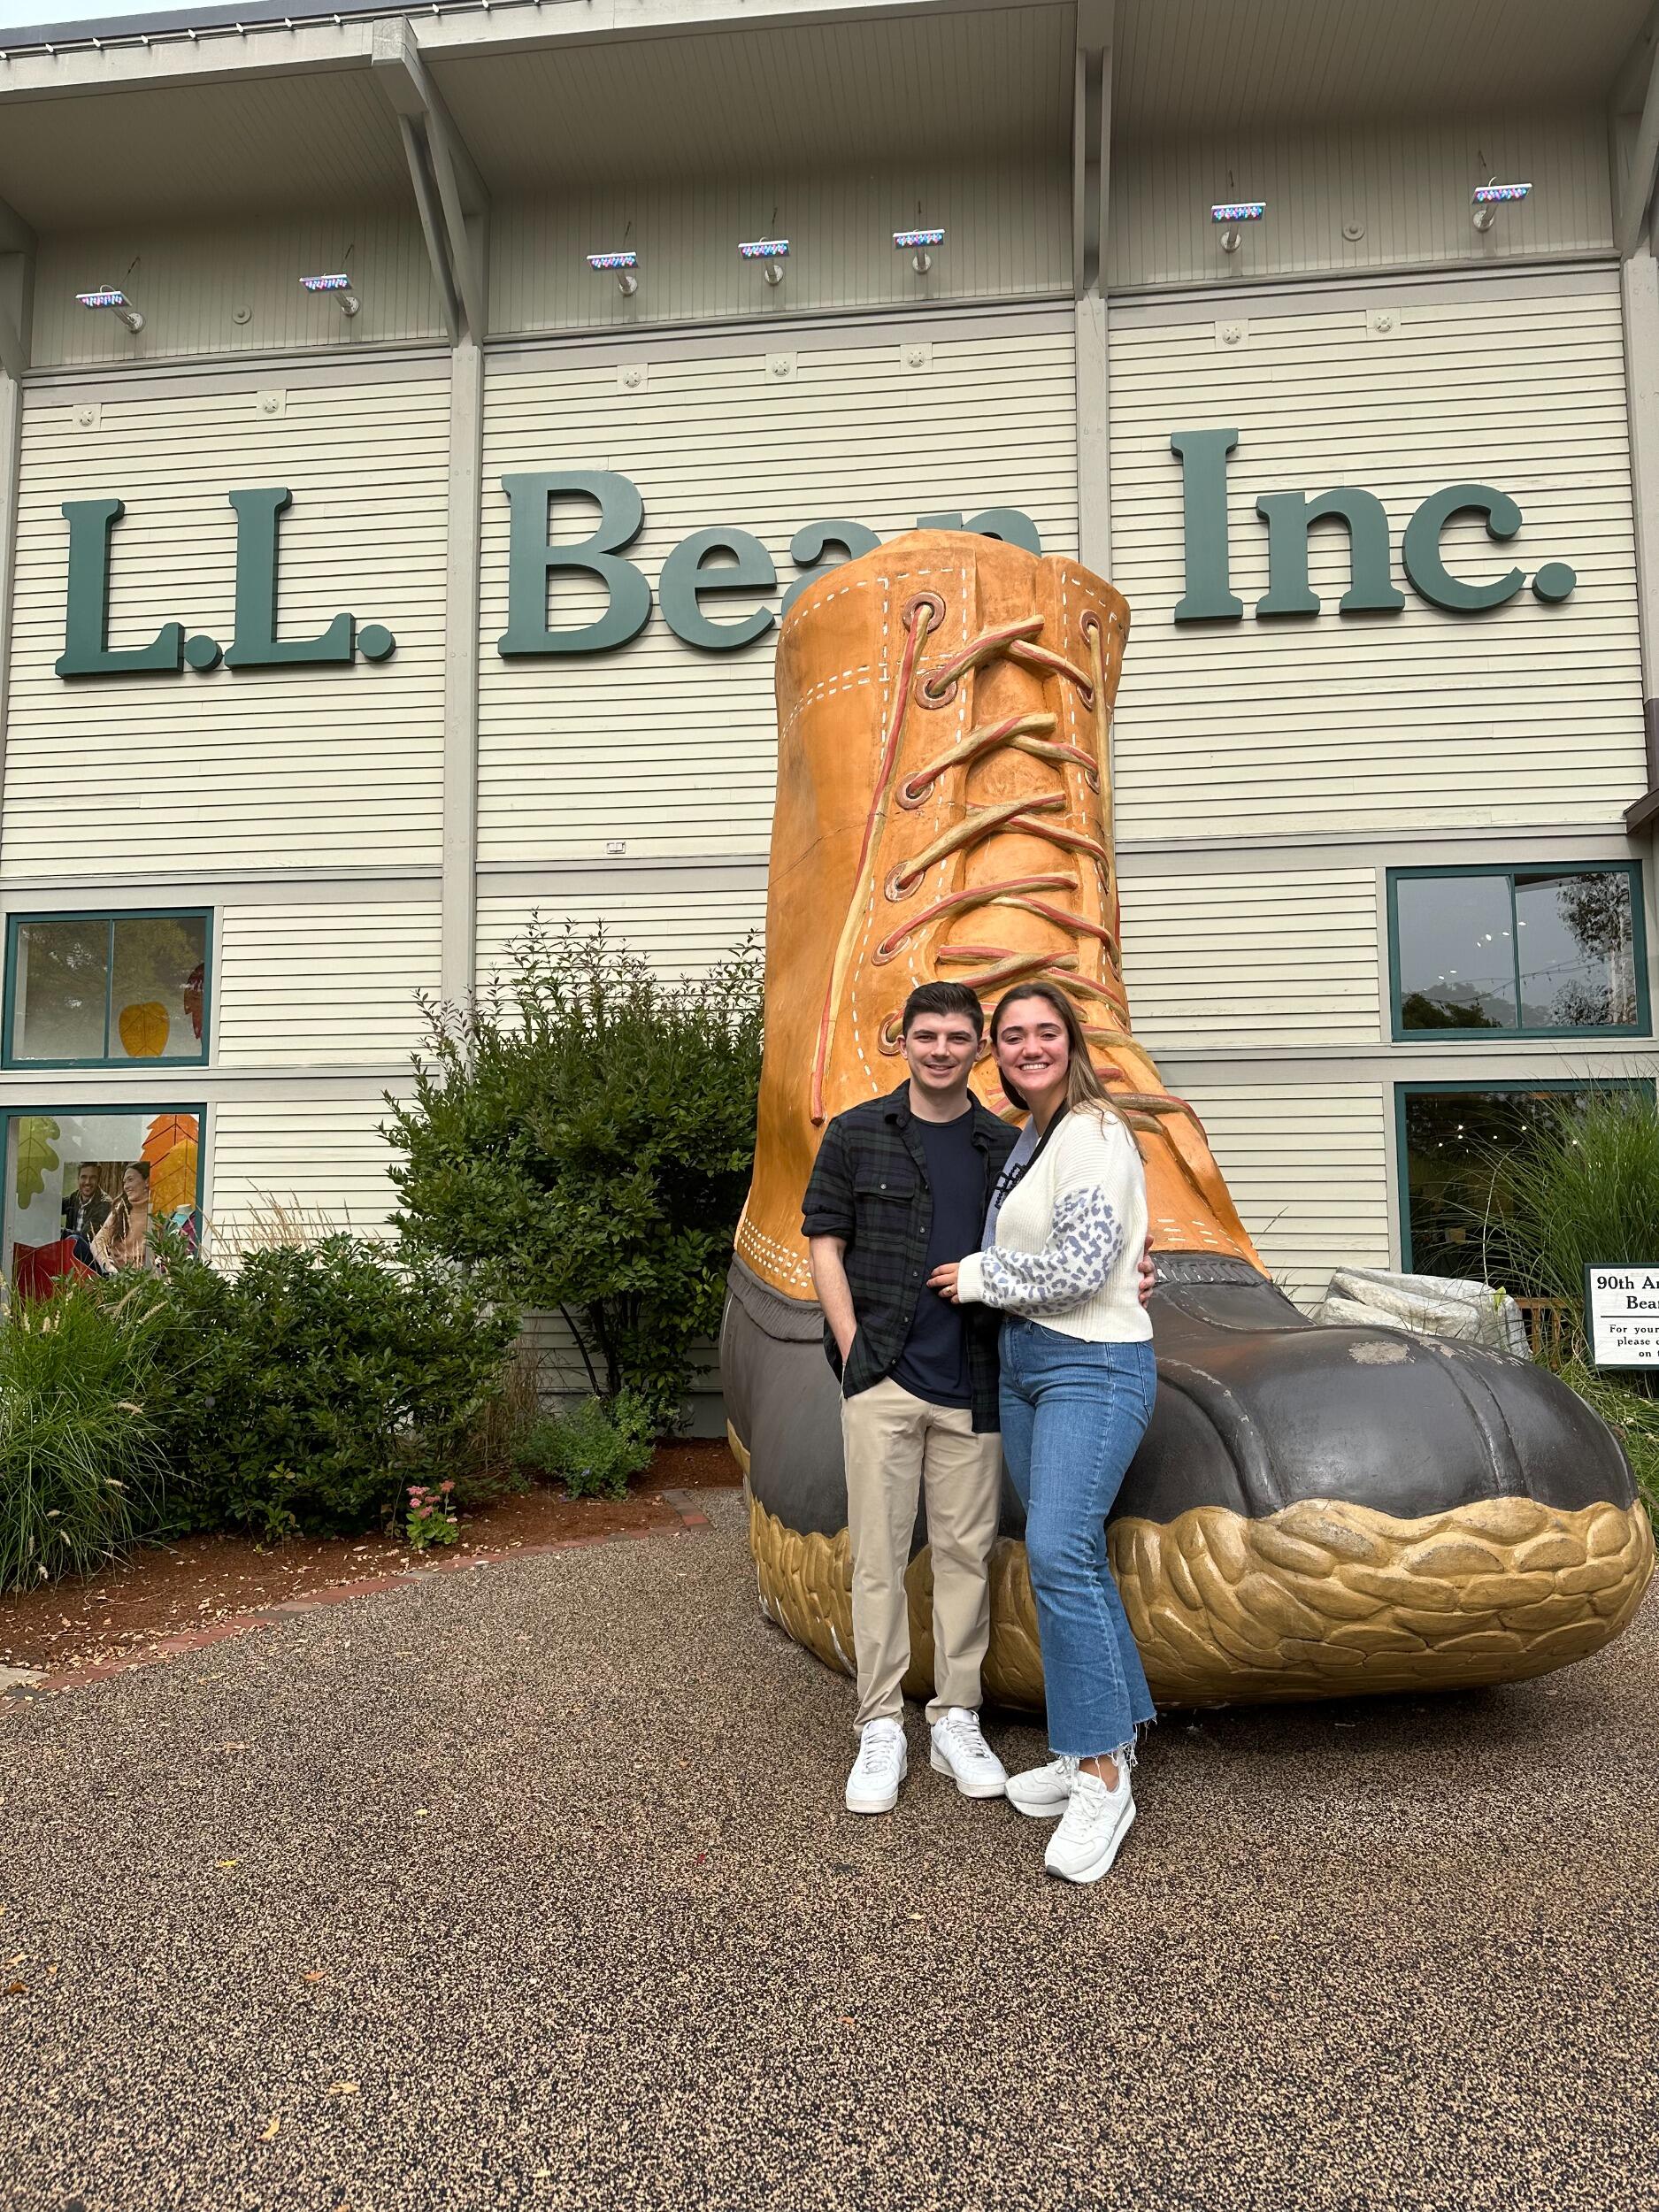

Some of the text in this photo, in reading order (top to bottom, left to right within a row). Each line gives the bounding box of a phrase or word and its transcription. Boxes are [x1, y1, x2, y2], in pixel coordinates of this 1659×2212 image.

[55, 428, 1577, 679] L.L. Be Inc.
[1596, 1275, 1635, 1290] 90th
[1625, 1295, 1659, 1310] Bea
[1609, 1324, 1628, 1333] For
[1617, 1336, 1651, 1348] please
